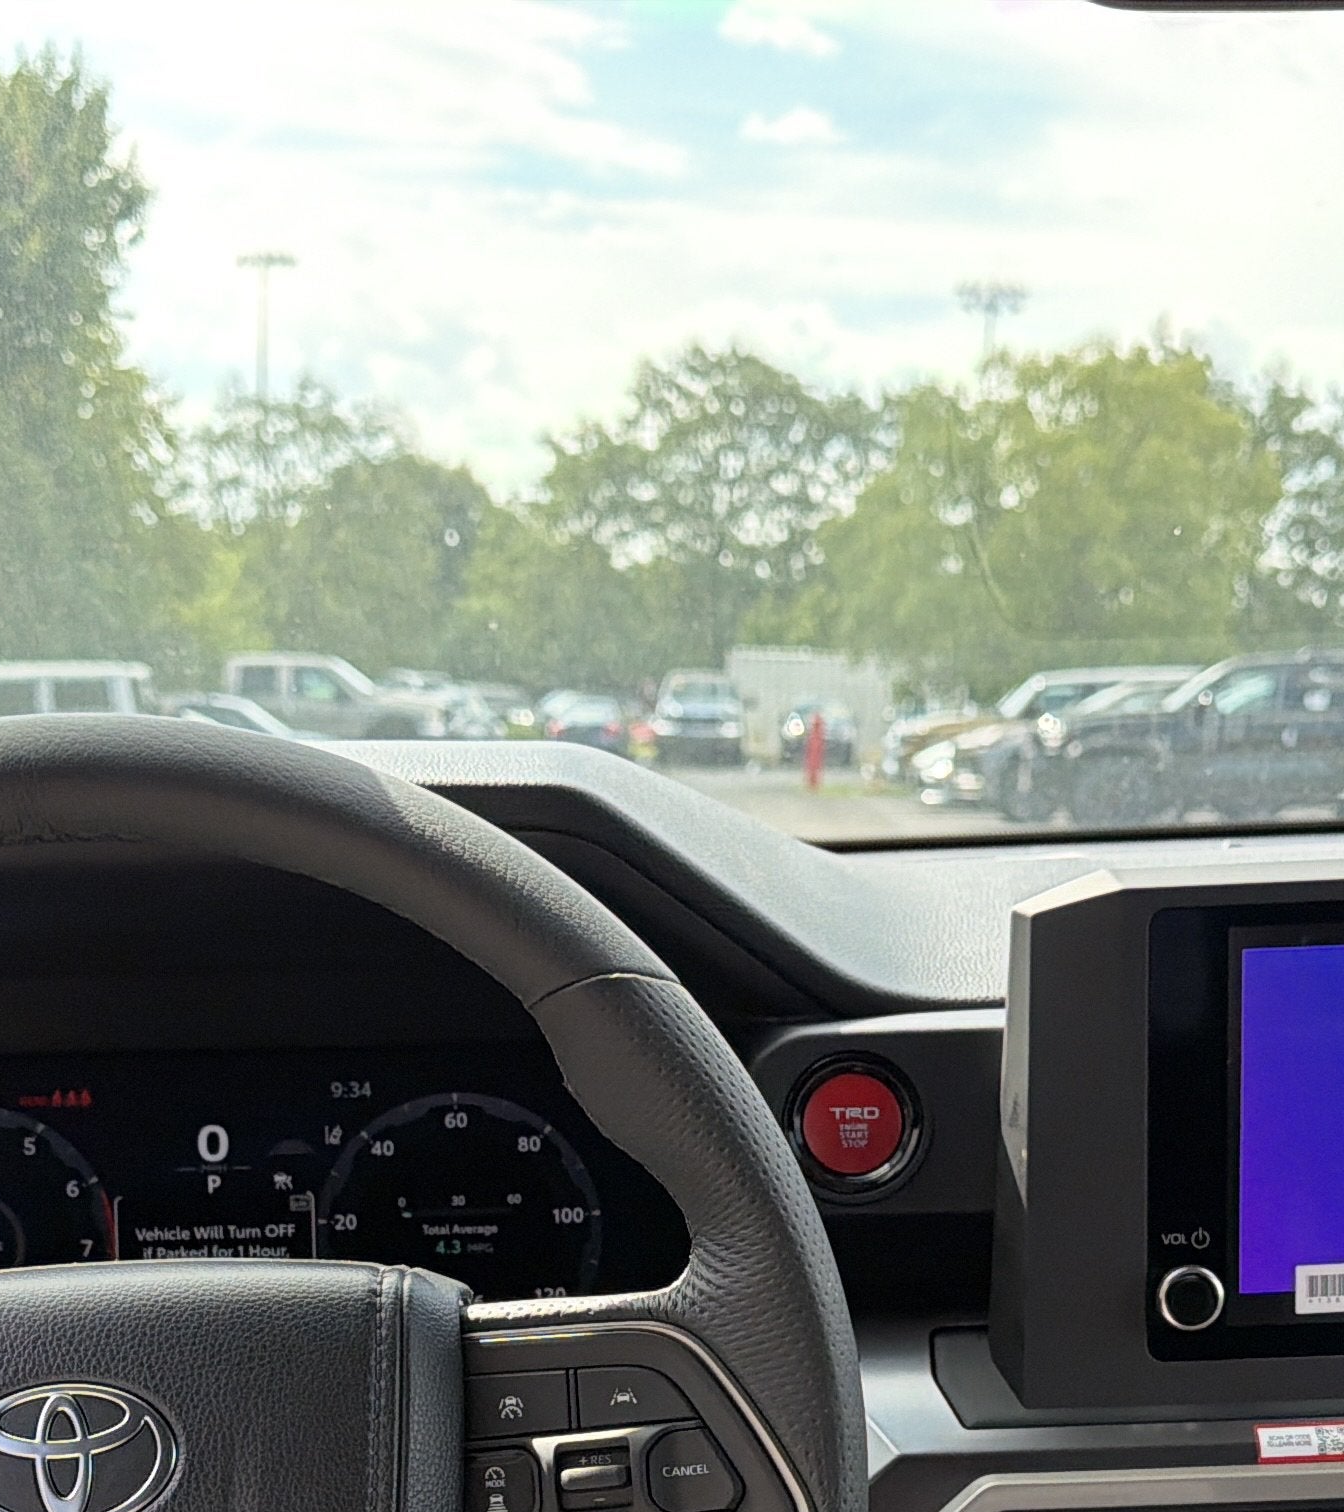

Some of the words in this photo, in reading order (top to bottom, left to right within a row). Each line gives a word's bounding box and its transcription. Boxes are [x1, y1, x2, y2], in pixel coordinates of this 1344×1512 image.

[331, 1082, 372, 1098] 9:34
[444, 1112, 468, 1128] 60
[829, 1107, 880, 1120] TRD
[23, 1136, 36, 1156] 5
[197, 1124, 229, 1162] 0
[371, 1140, 394, 1156] 40
[518, 1136, 541, 1152] 80
[842, 1139, 868, 1149] STOP
[66, 1180, 80, 1198] 6
[208, 1175, 221, 1194] P
[334, 1214, 357, 1231] 20
[553, 1207, 585, 1225] 100
[135, 1226, 191, 1242] Vehicle
[194, 1225, 225, 1240] Will
[227, 1224, 262, 1239] Turn
[264, 1223, 296, 1238] OFF
[422, 1223, 450, 1236] Total
[452, 1222, 499, 1236] Average
[436, 1240, 462, 1254] 4.3
[1161, 1233, 1188, 1245] VOL
[80, 1239, 93, 1257] 7
[156, 1246, 208, 1258] Parked
[211, 1245, 234, 1258] for
[662, 1464, 710, 1478] CANCEL
[484, 1479, 506, 1488] MODE
